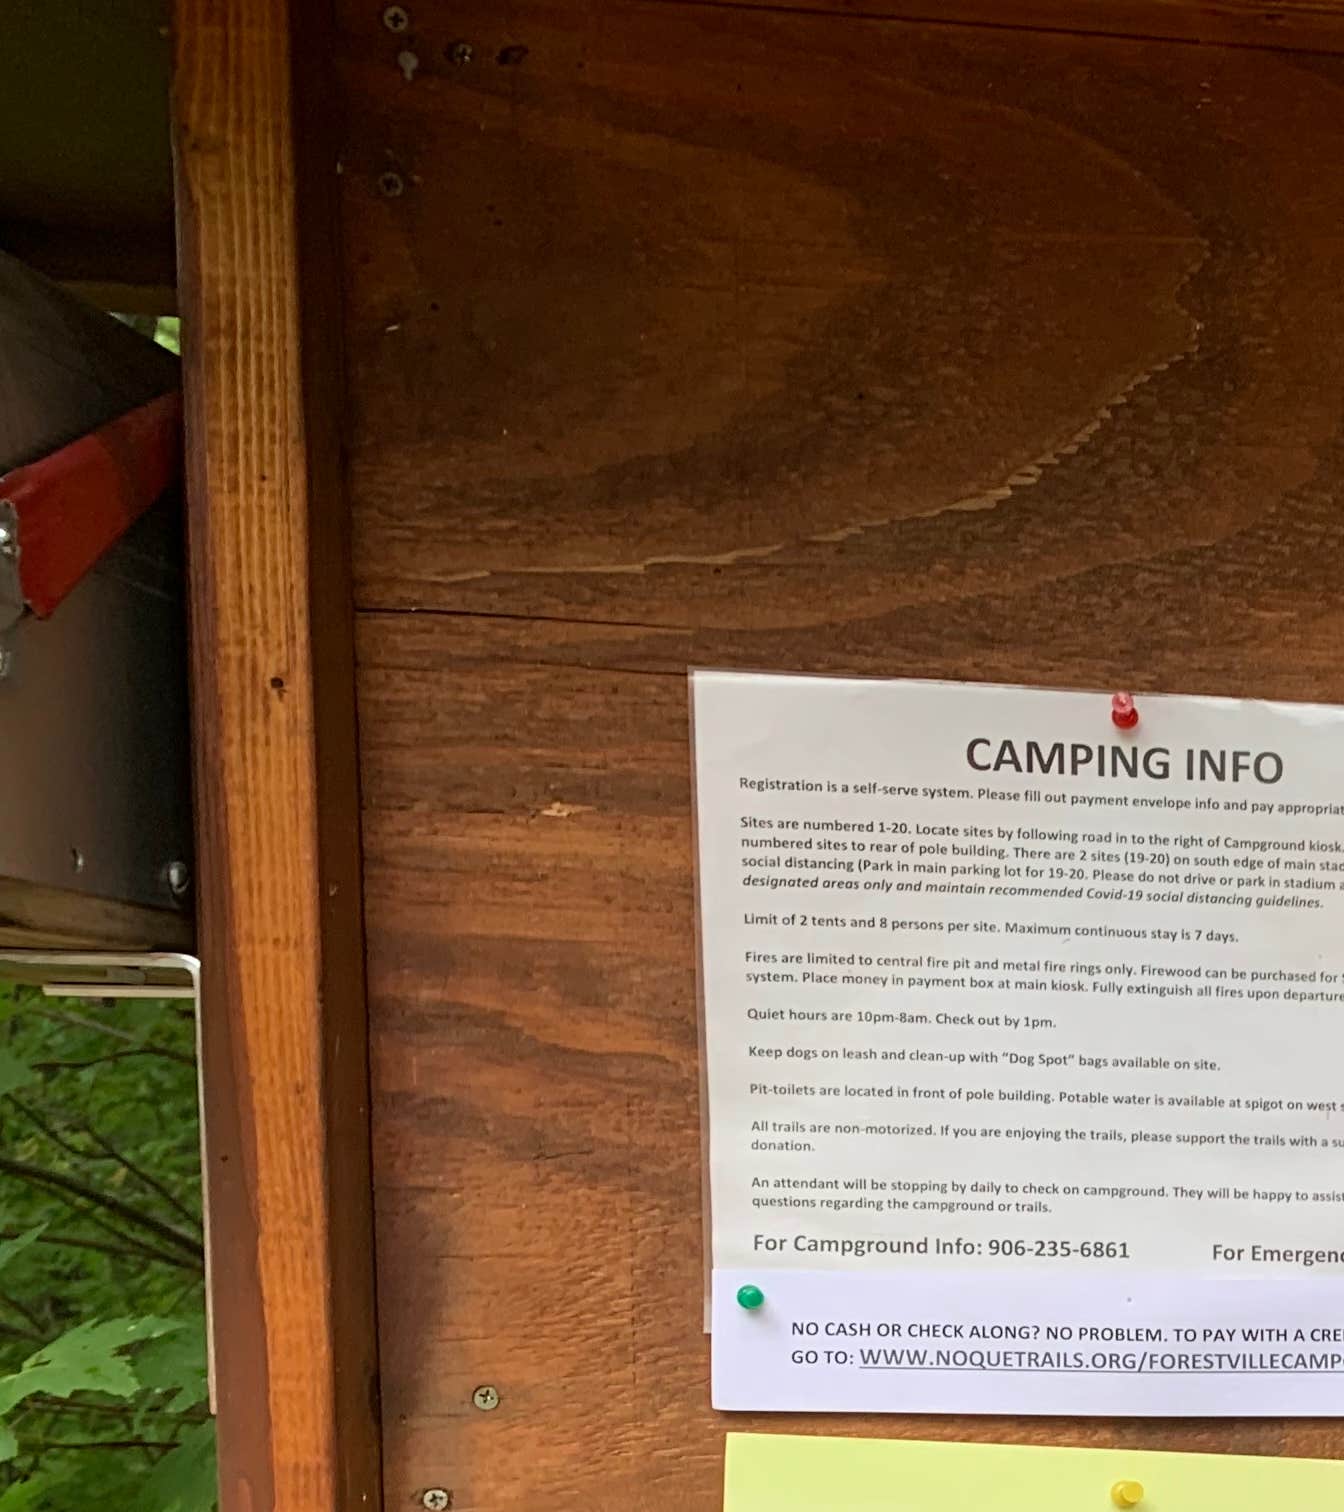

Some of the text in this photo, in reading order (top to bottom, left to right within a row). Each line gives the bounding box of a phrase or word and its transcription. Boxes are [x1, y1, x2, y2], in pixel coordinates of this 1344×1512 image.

[966, 736, 1284, 785] CAMPING INFO
[739, 776, 823, 793] Registration
[826, 779, 838, 793] is
[841, 783, 850, 795] a
[852, 781, 919, 798] self-serve
[921, 786, 974, 800] system.
[977, 787, 1021, 802] Please
[1023, 789, 1041, 803] fill
[1044, 792, 1067, 804] out
[1070, 794, 1129, 808] payment
[1131, 795, 1192, 812] envelope
[1195, 796, 1220, 811] info
[1223, 798, 1248, 812] and
[1251, 802, 1275, 816] pay
[747, 1006, 1057, 1031] Quiet hours are 10pm-8am. Check out by 1pm.
[753, 1233, 1130, 1259] For Campground Info: 906-235-6861
[1212, 1243, 1245, 1262] For
[791, 1321, 819, 1337] NO
[824, 1321, 871, 1337] CASH
[876, 1322, 902, 1339] OR
[907, 1323, 964, 1339] CHECK
[968, 1324, 1041, 1341] ALONG?
[1046, 1325, 1073, 1342] NO
[1078, 1326, 1168, 1344] PROBLEM.
[1173, 1328, 1197, 1343] TO
[1202, 1327, 1237, 1343] PAY
[1241, 1327, 1288, 1343] WITH
[1293, 1327, 1306, 1343] A
[791, 1349, 819, 1365] GO
[823, 1349, 854, 1366] TO:
